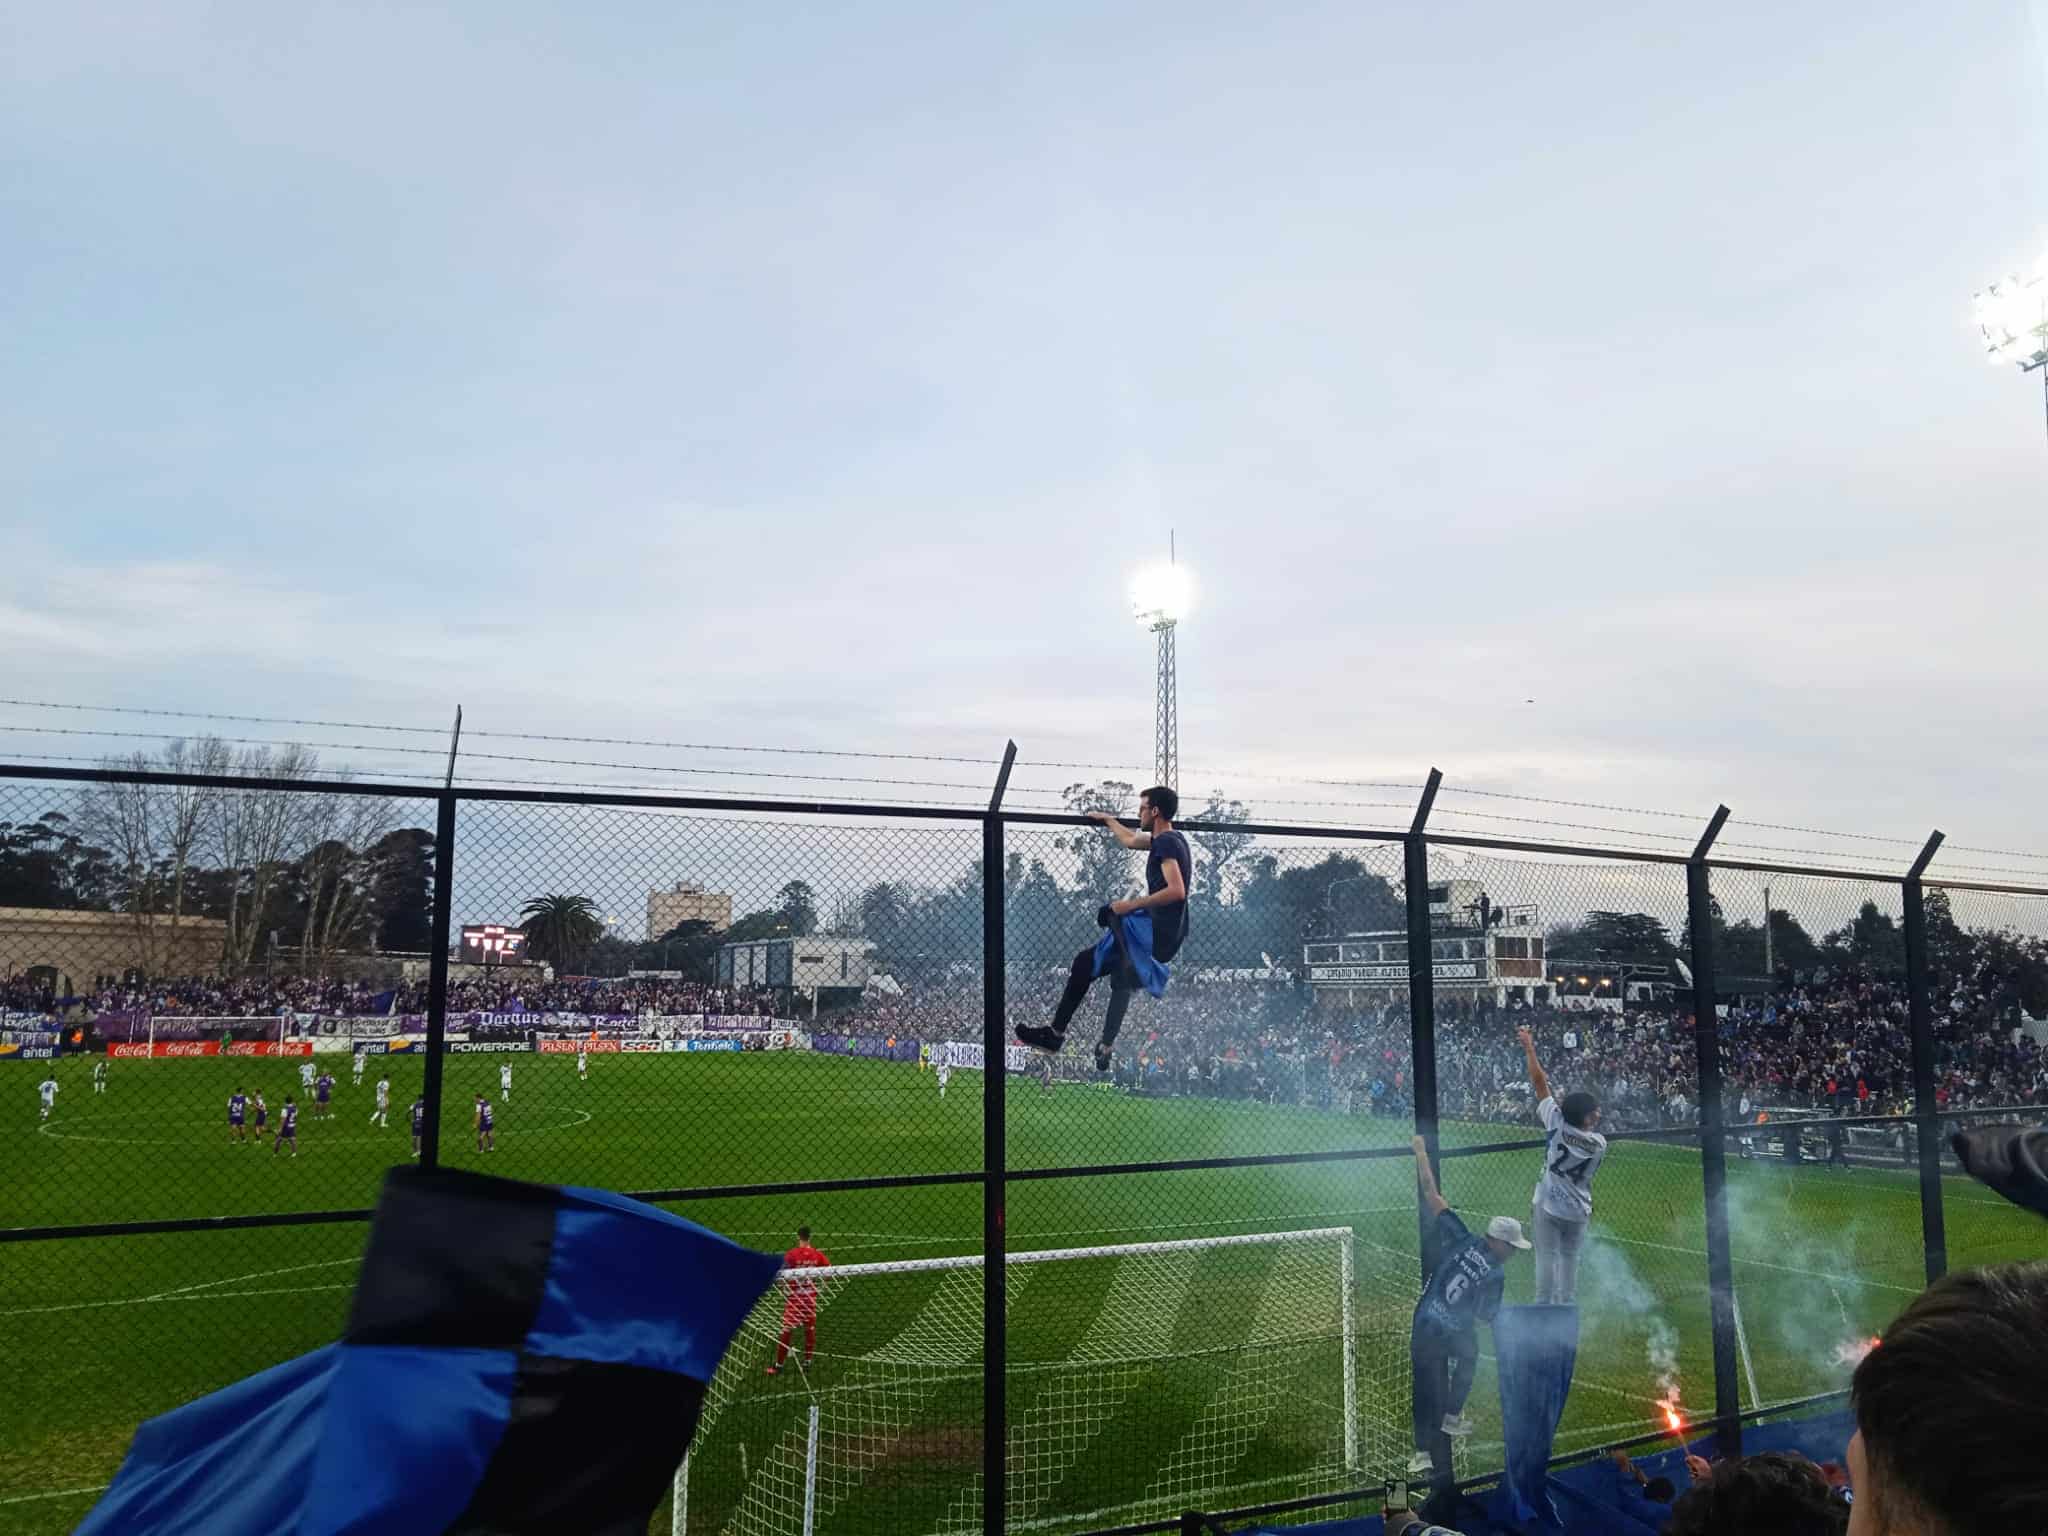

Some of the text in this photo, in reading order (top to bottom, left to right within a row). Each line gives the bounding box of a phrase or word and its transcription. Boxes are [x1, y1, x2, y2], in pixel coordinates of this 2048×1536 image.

[22, 1046, 53, 1058] antel
[450, 1041, 530, 1053] POWERADE
[541, 1041, 575, 1052] PILSEN
[1549, 1142, 1592, 1186] 24
[1446, 1273, 1469, 1305] 6
